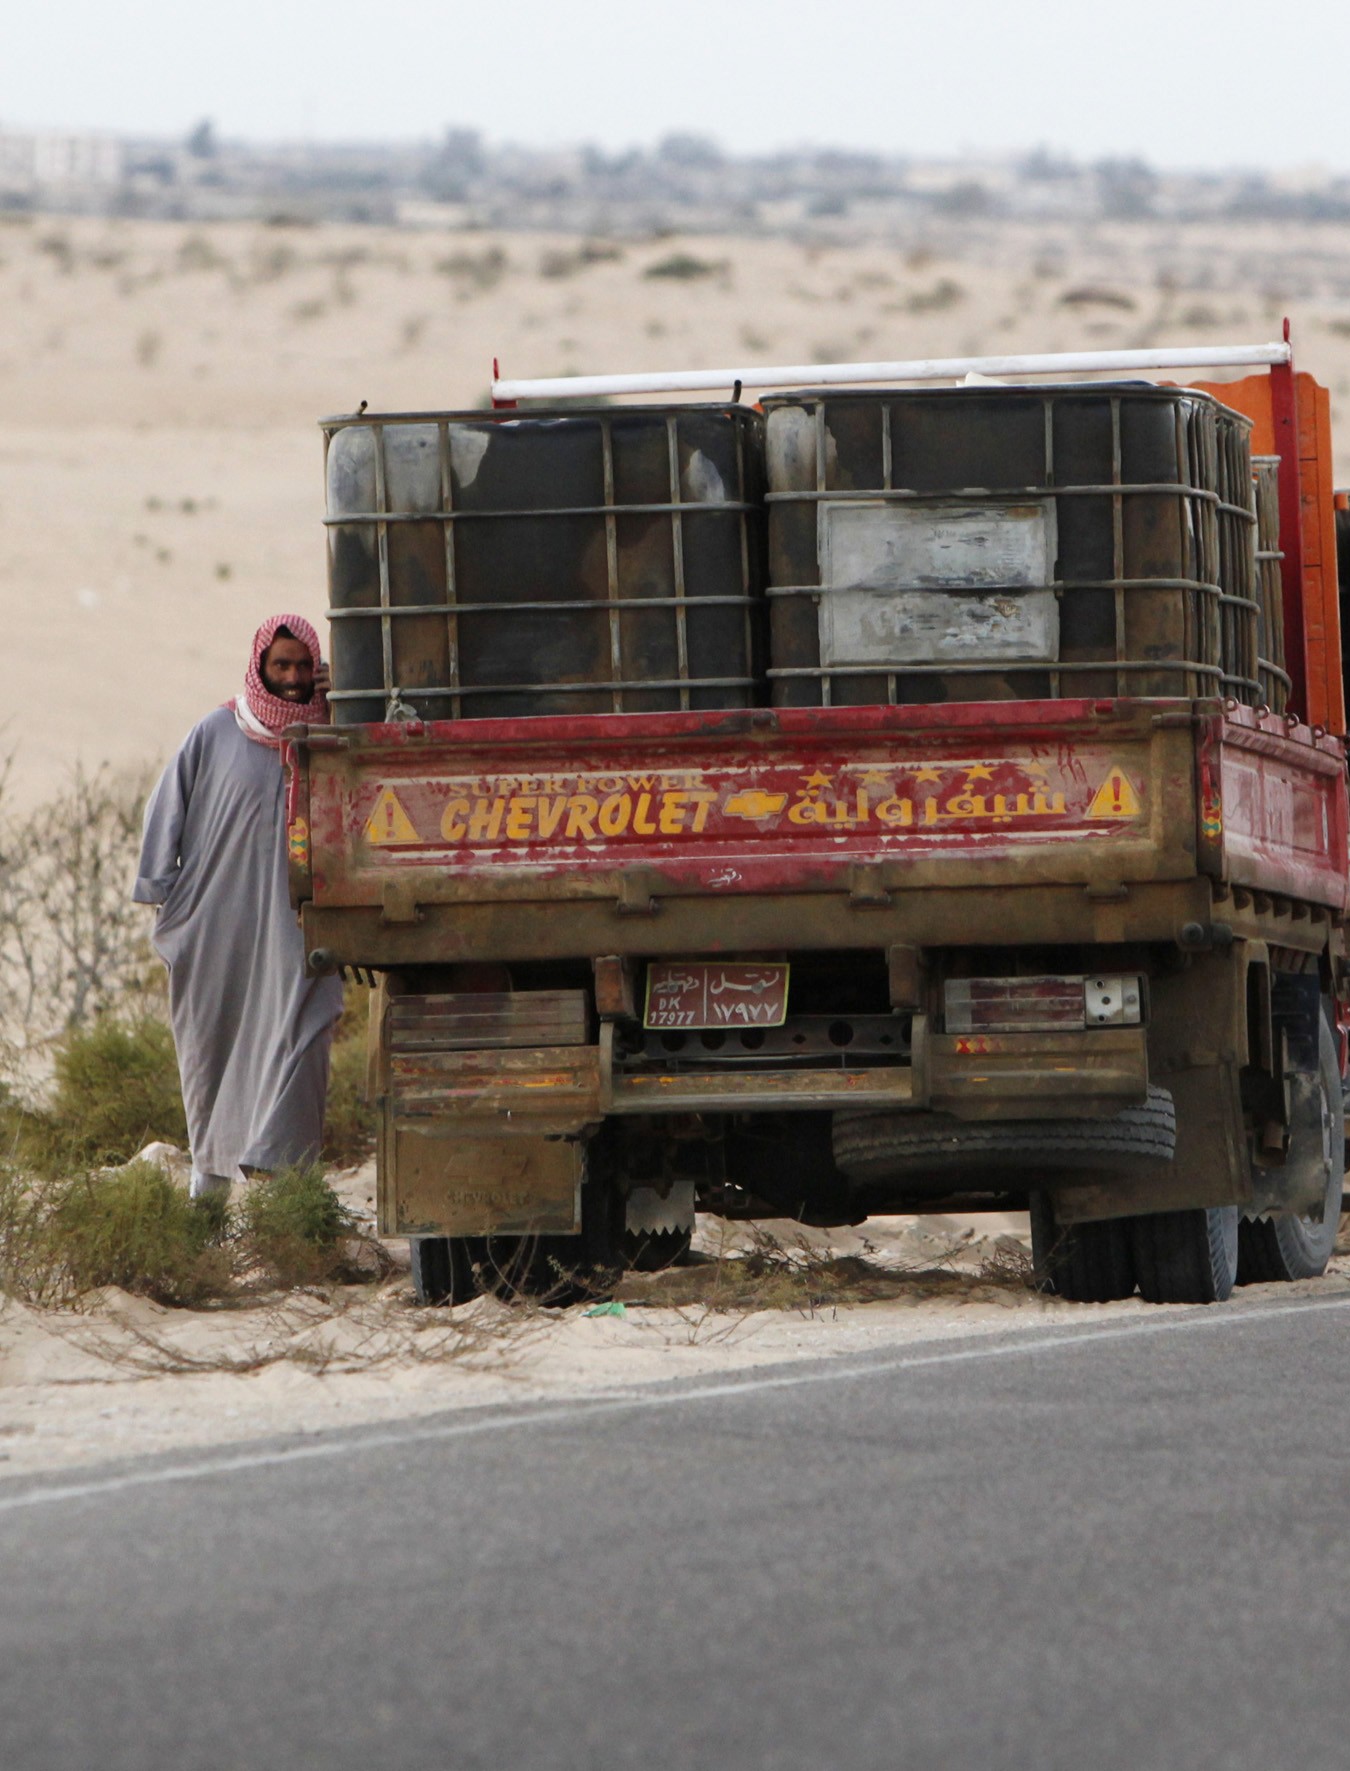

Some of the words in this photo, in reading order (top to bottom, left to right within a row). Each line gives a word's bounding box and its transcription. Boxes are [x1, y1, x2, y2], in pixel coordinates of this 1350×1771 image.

[448, 777, 565, 798] SUPER
[576, 774, 708, 794] POWER
[440, 791, 719, 842] CHEVROLET
[710, 969, 780, 994] نقل
[659, 995, 681, 1010] DK
[713, 1002, 779, 1023] ١٧٩٧٧
[650, 1011, 696, 1026] 17977
